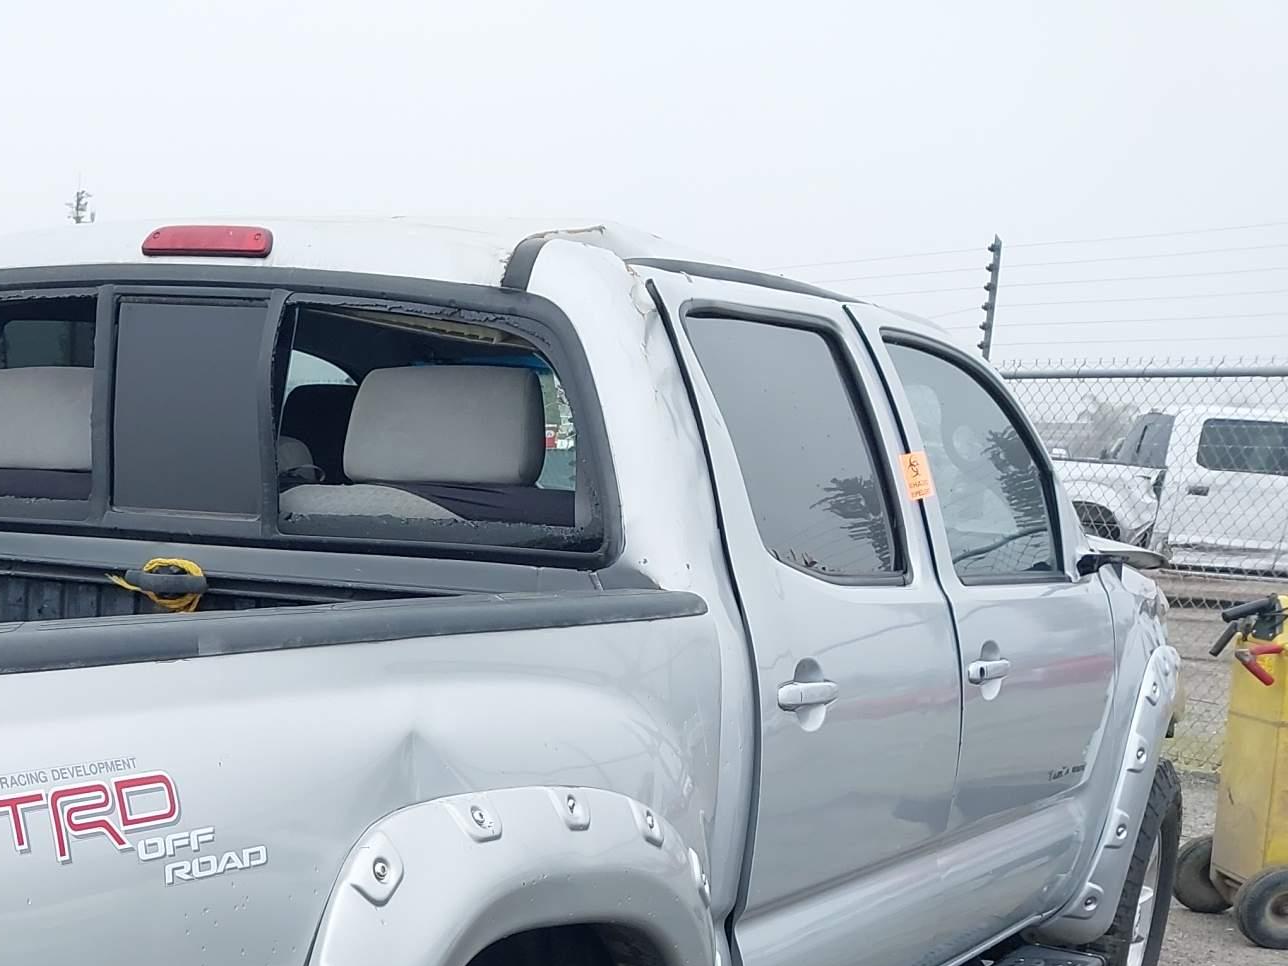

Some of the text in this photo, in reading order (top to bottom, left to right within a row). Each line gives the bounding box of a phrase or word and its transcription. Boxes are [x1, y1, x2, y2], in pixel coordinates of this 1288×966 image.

[0, 770, 49, 789] RACING
[51, 757, 138, 781] DEVELOPMENT
[136, 826, 216, 861] OFF
[165, 845, 268, 885] ROAD
